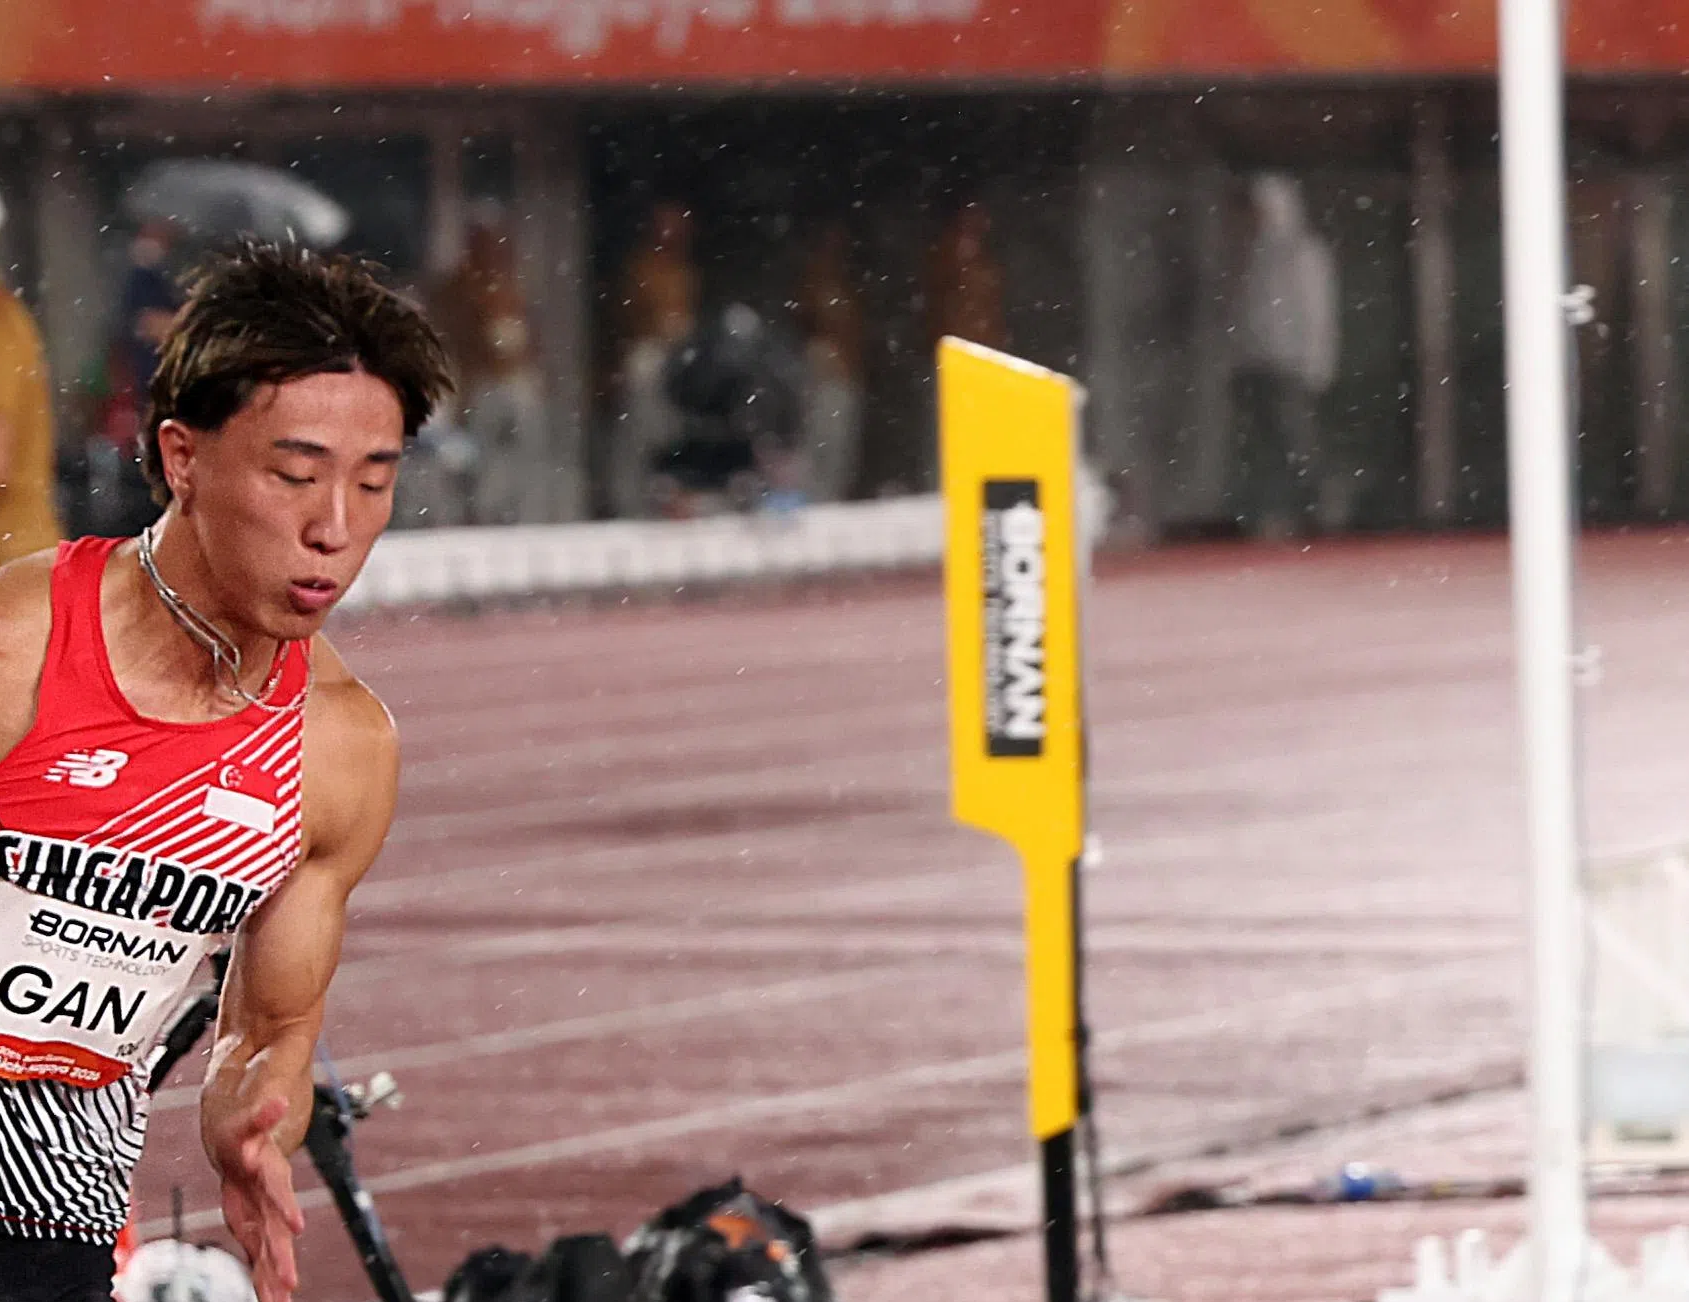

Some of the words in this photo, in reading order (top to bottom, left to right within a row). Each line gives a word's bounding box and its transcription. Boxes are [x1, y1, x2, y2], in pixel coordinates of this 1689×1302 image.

[21, 934, 79, 962] SPORTS
[84, 950, 171, 978] TECHNOLOGY
[29, 909, 189, 964] BORNAN
